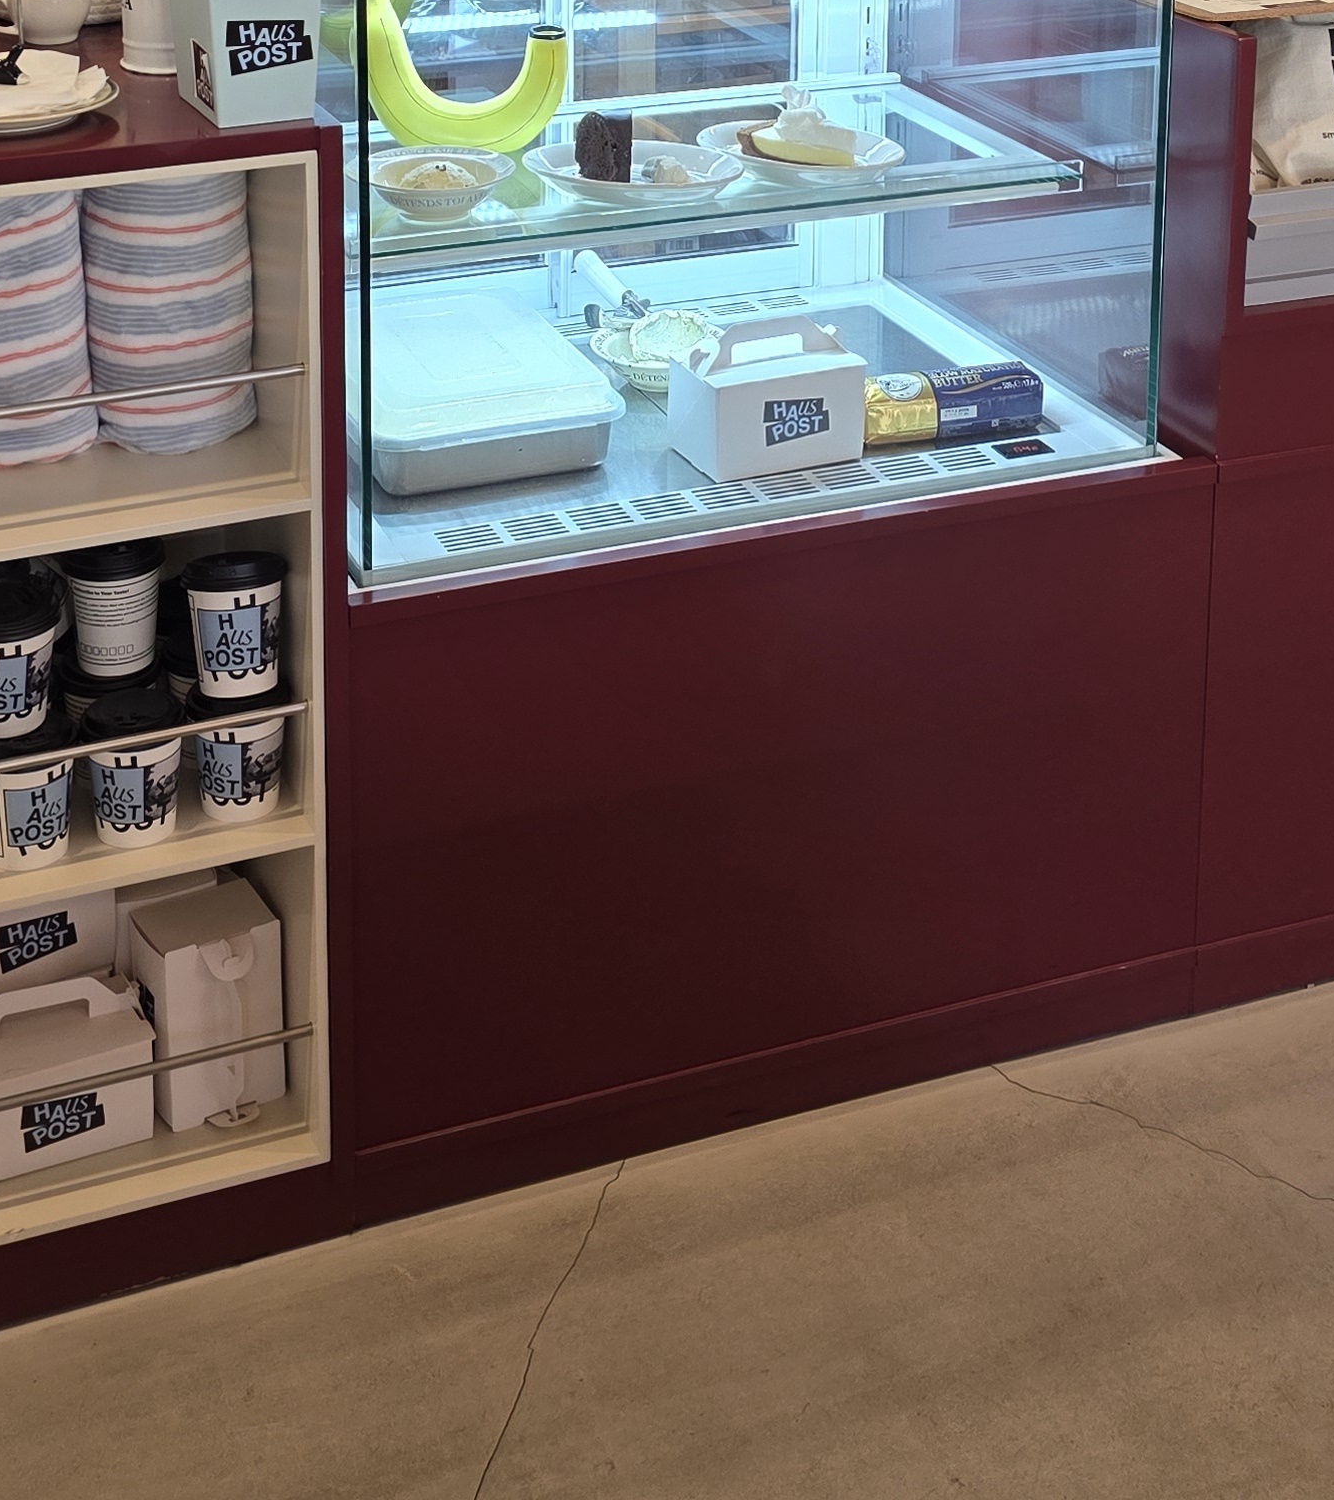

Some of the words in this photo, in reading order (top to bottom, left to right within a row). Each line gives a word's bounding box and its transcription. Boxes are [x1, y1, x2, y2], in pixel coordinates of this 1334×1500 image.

[239, 22, 295, 46] HAUS
[237, 41, 302, 71] POST
[633, 371, 669, 383] DÉTEN
[933, 374, 983, 388] BUTTER
[773, 400, 817, 421] HAUS
[772, 415, 823, 441] POST
[203, 647, 259, 668] POST
[94, 801, 142, 821] POST
[10, 816, 66, 844] POST
[7, 914, 61, 944] HAUS
[7, 929, 69, 967] POST
[33, 1095, 89, 1124] HAUS
[32, 1109, 96, 1147] POST
